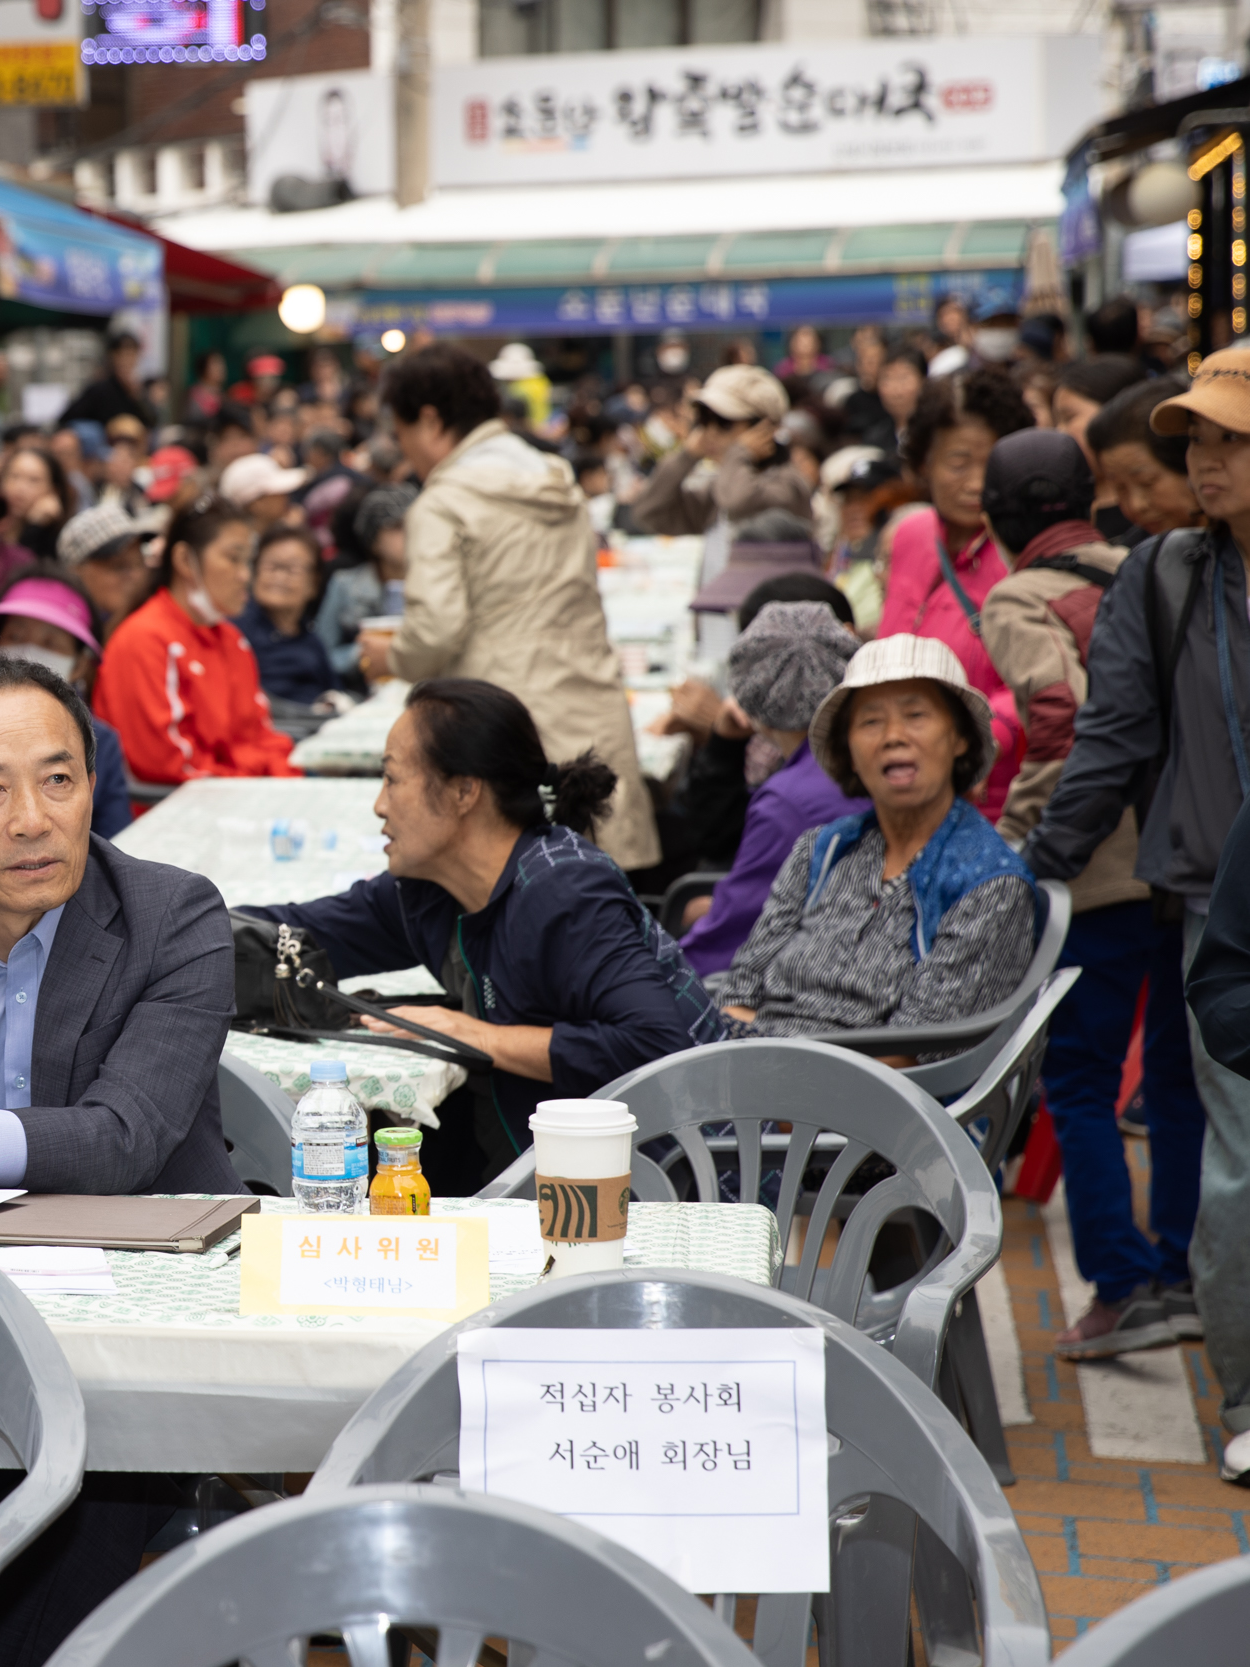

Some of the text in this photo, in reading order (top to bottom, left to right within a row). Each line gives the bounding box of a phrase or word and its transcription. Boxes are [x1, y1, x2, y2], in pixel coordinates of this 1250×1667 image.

[540, 1381, 742, 1414] 적십자 봉사회
[549, 1439, 751, 1471] 서순애 회장님
